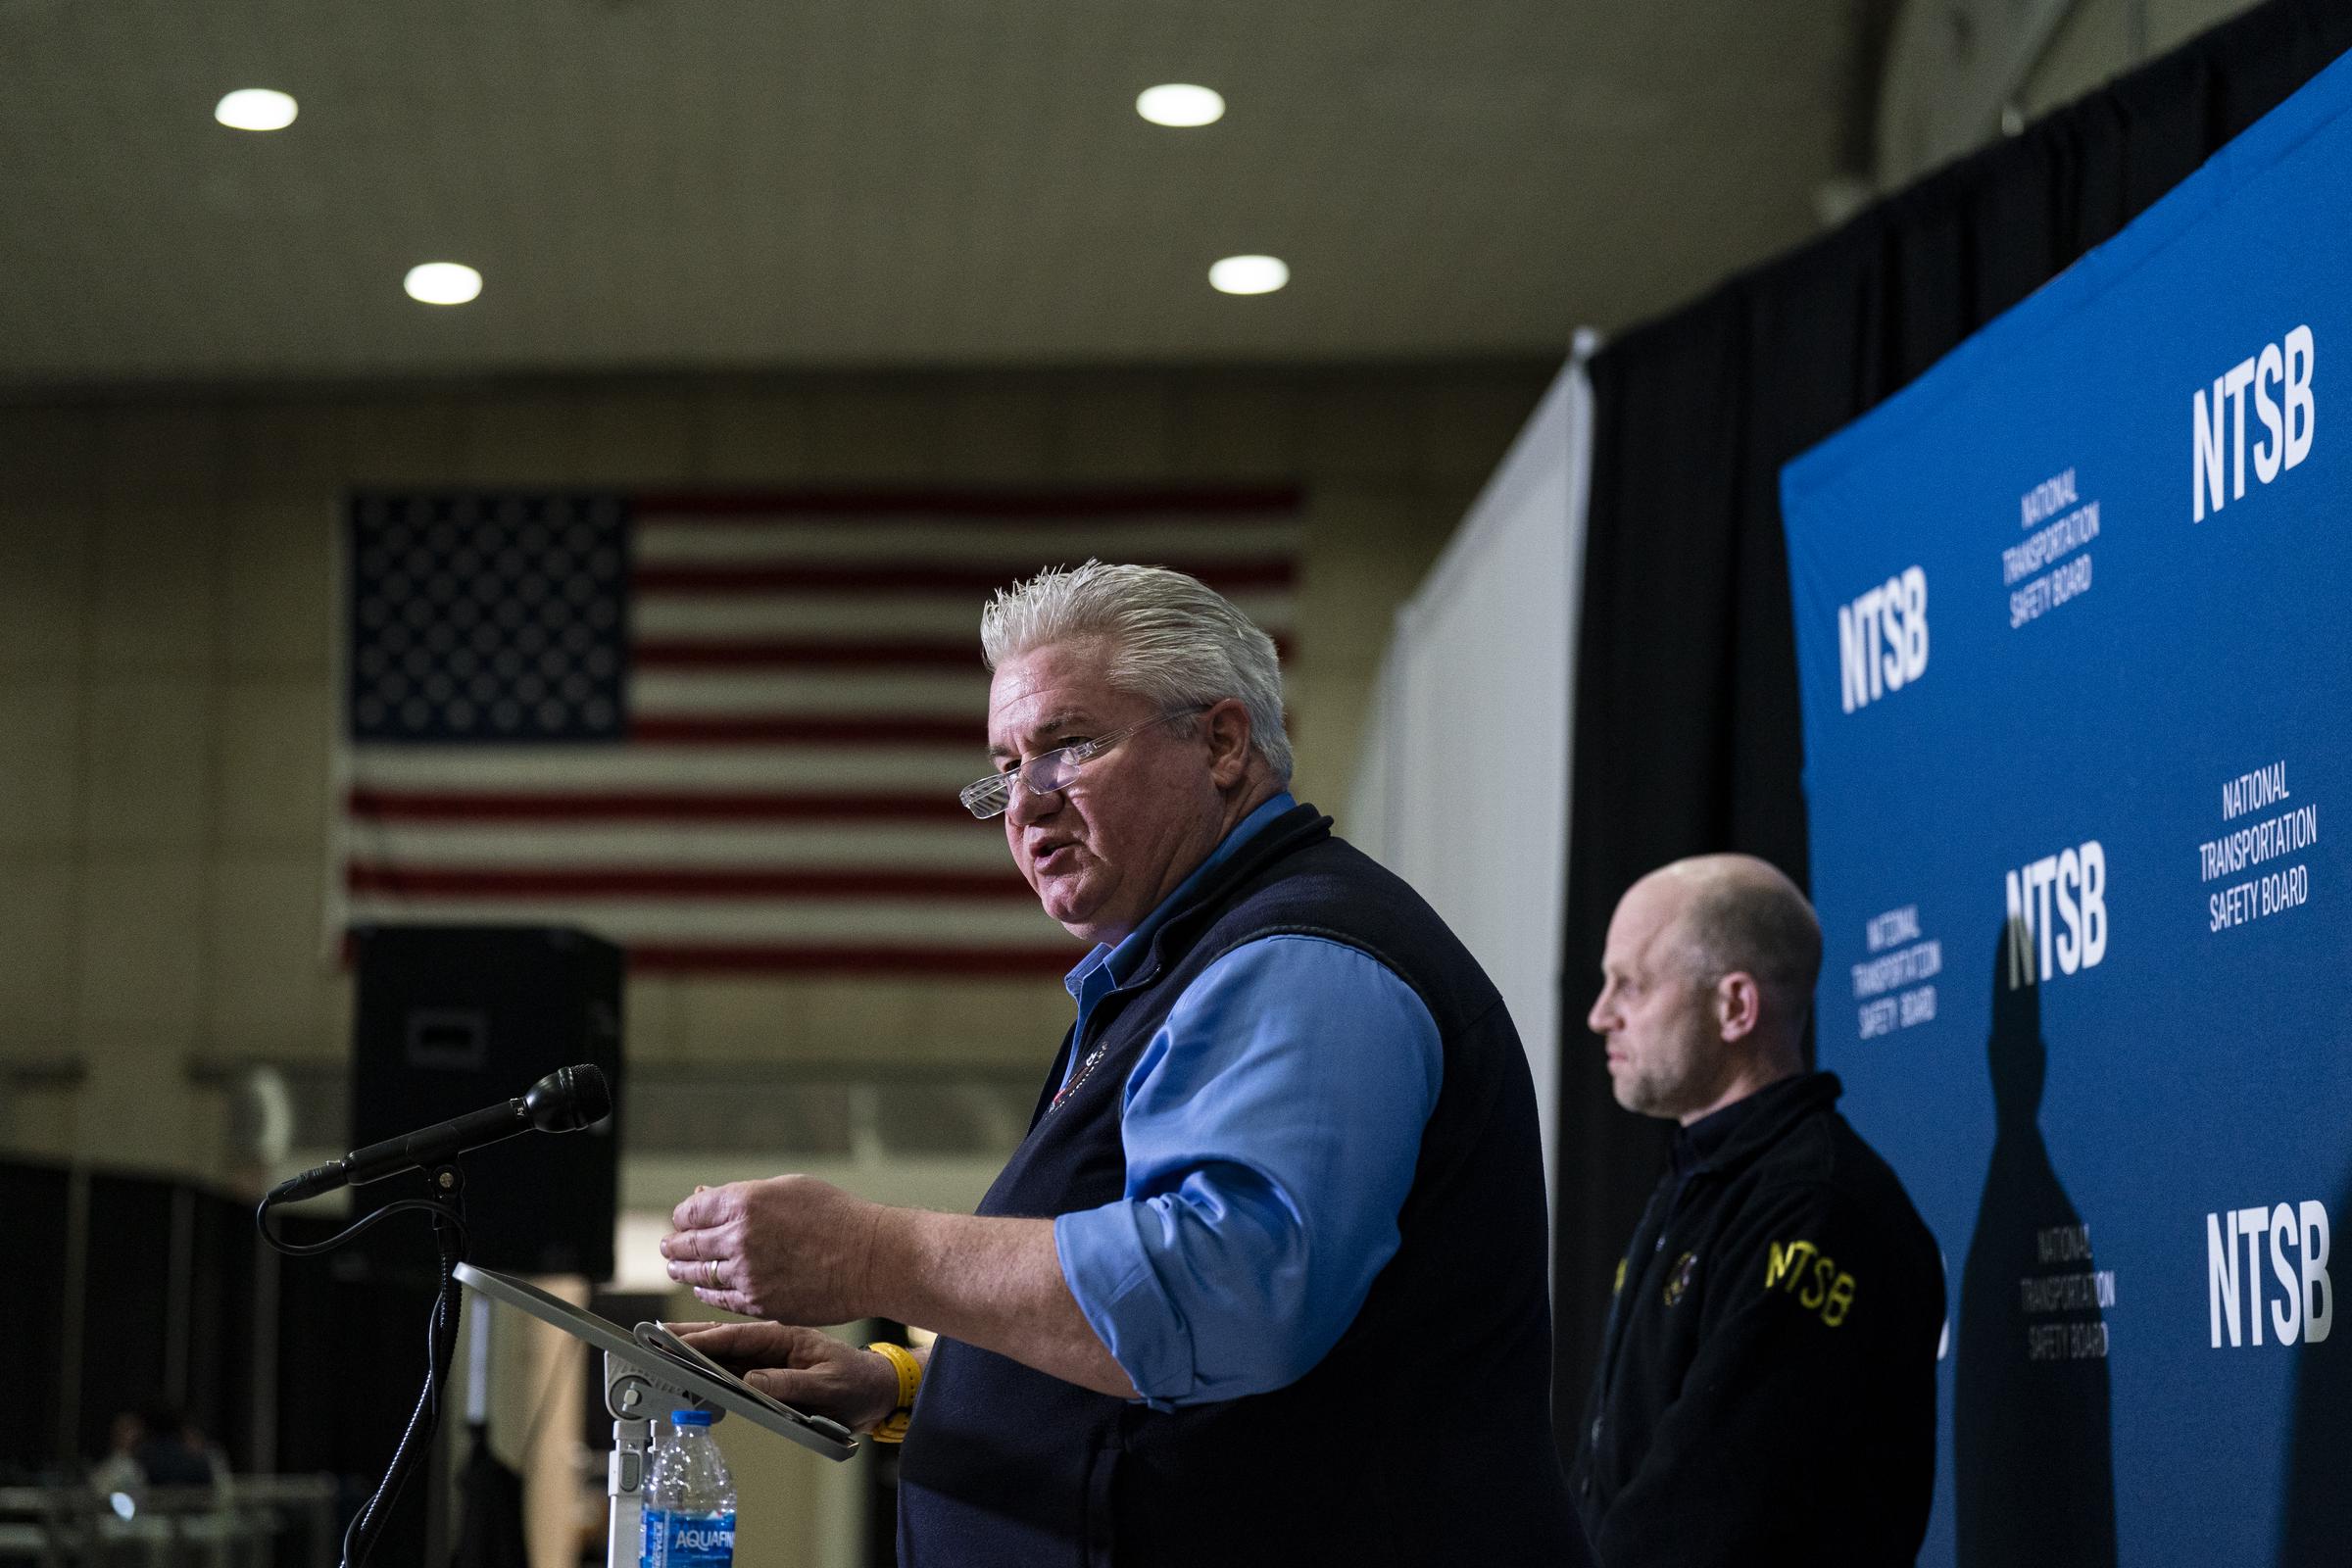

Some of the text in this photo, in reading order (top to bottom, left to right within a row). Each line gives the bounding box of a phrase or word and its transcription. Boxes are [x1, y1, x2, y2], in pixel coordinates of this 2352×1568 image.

[2192, 324, 2315, 524] NTSB
[1838, 564, 1929, 714] NTSB
[2199, 804, 2317, 882] TRANSPORTATION
[2223, 760, 2289, 821] NATIONAL
[2006, 840, 2108, 991] NTSB
[2210, 864, 2308, 933] SAFETY BOARD
[1766, 1240, 1855, 1327] NTSB
[2207, 1200, 2333, 1348] NTSB
